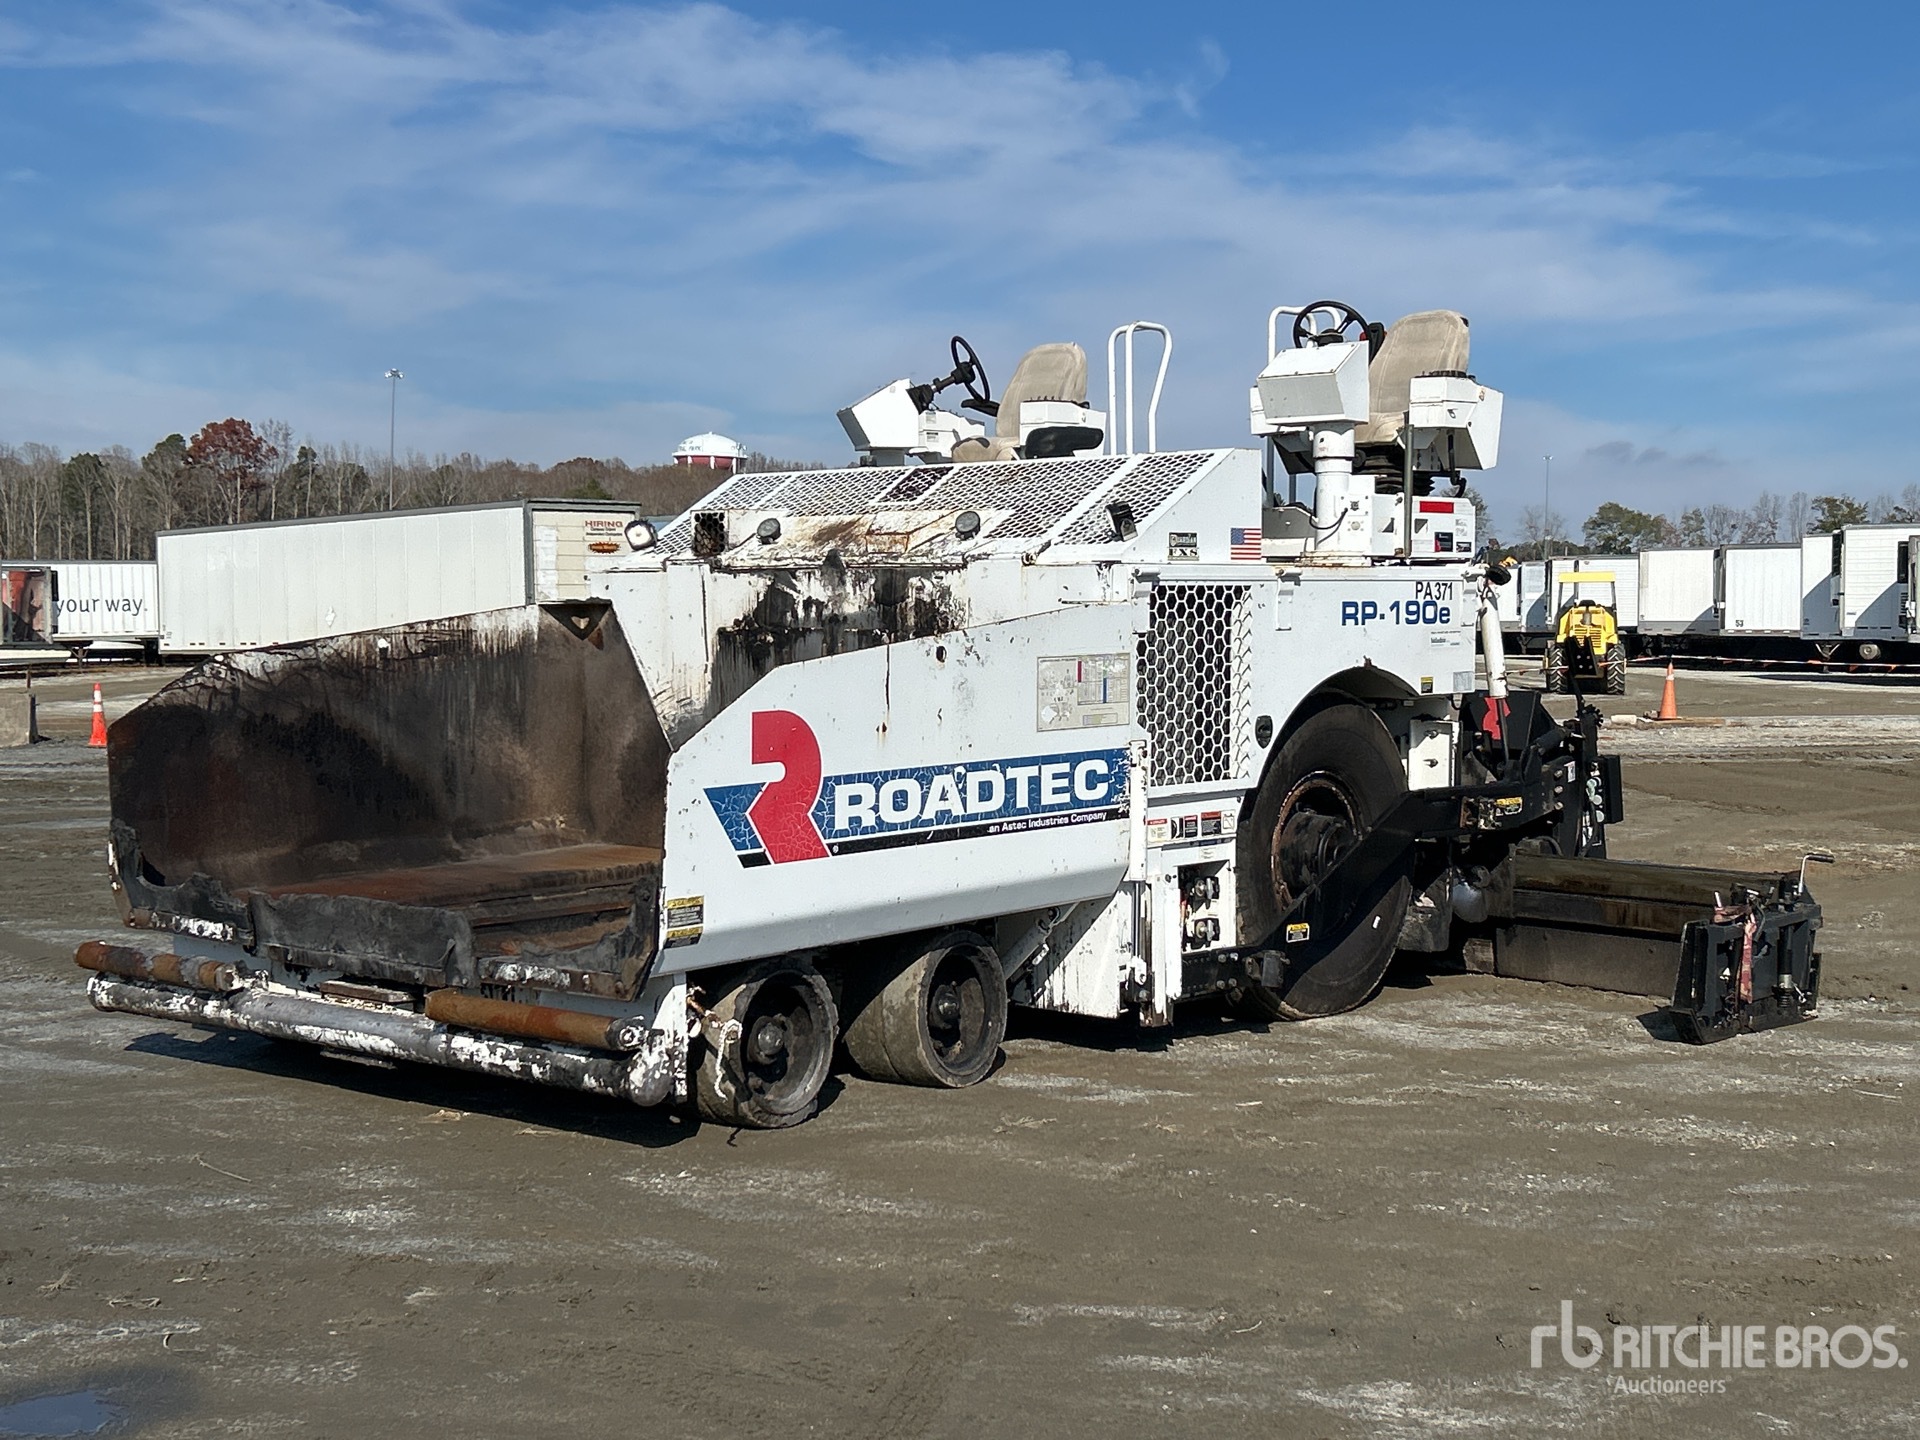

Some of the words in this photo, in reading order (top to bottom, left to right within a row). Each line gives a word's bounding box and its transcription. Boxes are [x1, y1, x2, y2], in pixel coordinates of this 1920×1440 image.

[585, 520, 624, 528] HIRING
[1415, 581, 1453, 601] PA371
[57, 598, 100, 618] your
[105, 598, 148, 617] way.
[1341, 600, 1451, 627] RP-190e
[834, 758, 1110, 831] ROADTEC
[988, 825, 1000, 833] an
[1001, 821, 1027, 832] Astec
[1028, 815, 1069, 829] Industries
[1070, 811, 1107, 824] Company
